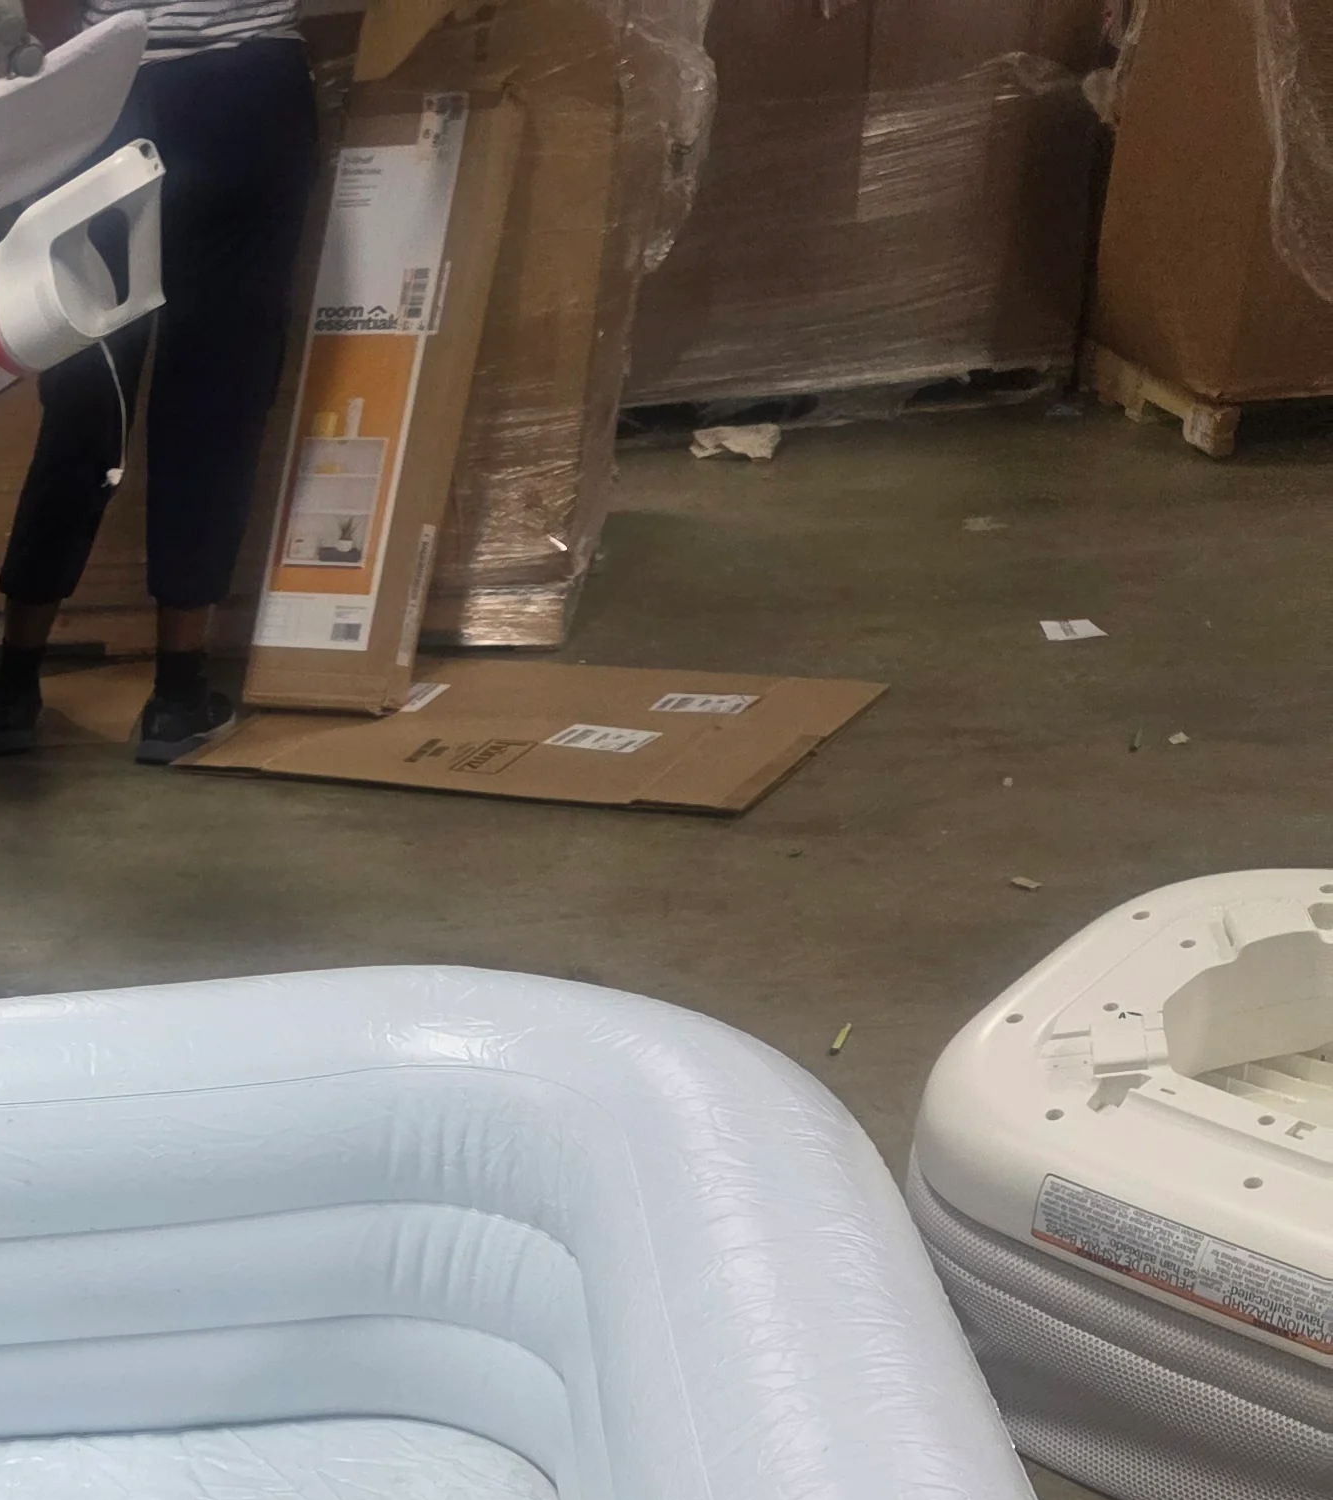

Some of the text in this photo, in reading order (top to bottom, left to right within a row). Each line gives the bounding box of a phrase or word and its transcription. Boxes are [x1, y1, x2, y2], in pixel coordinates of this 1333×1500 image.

[317, 305, 364, 318] room
[1076, 1236, 1122, 1264] ASFIXIA
[1140, 1262, 1196, 1292] PELIGRO
[1156, 1257, 1182, 1276] han
[1220, 1293, 1275, 1324] HAZARD
[1292, 1308, 1327, 1333] have
